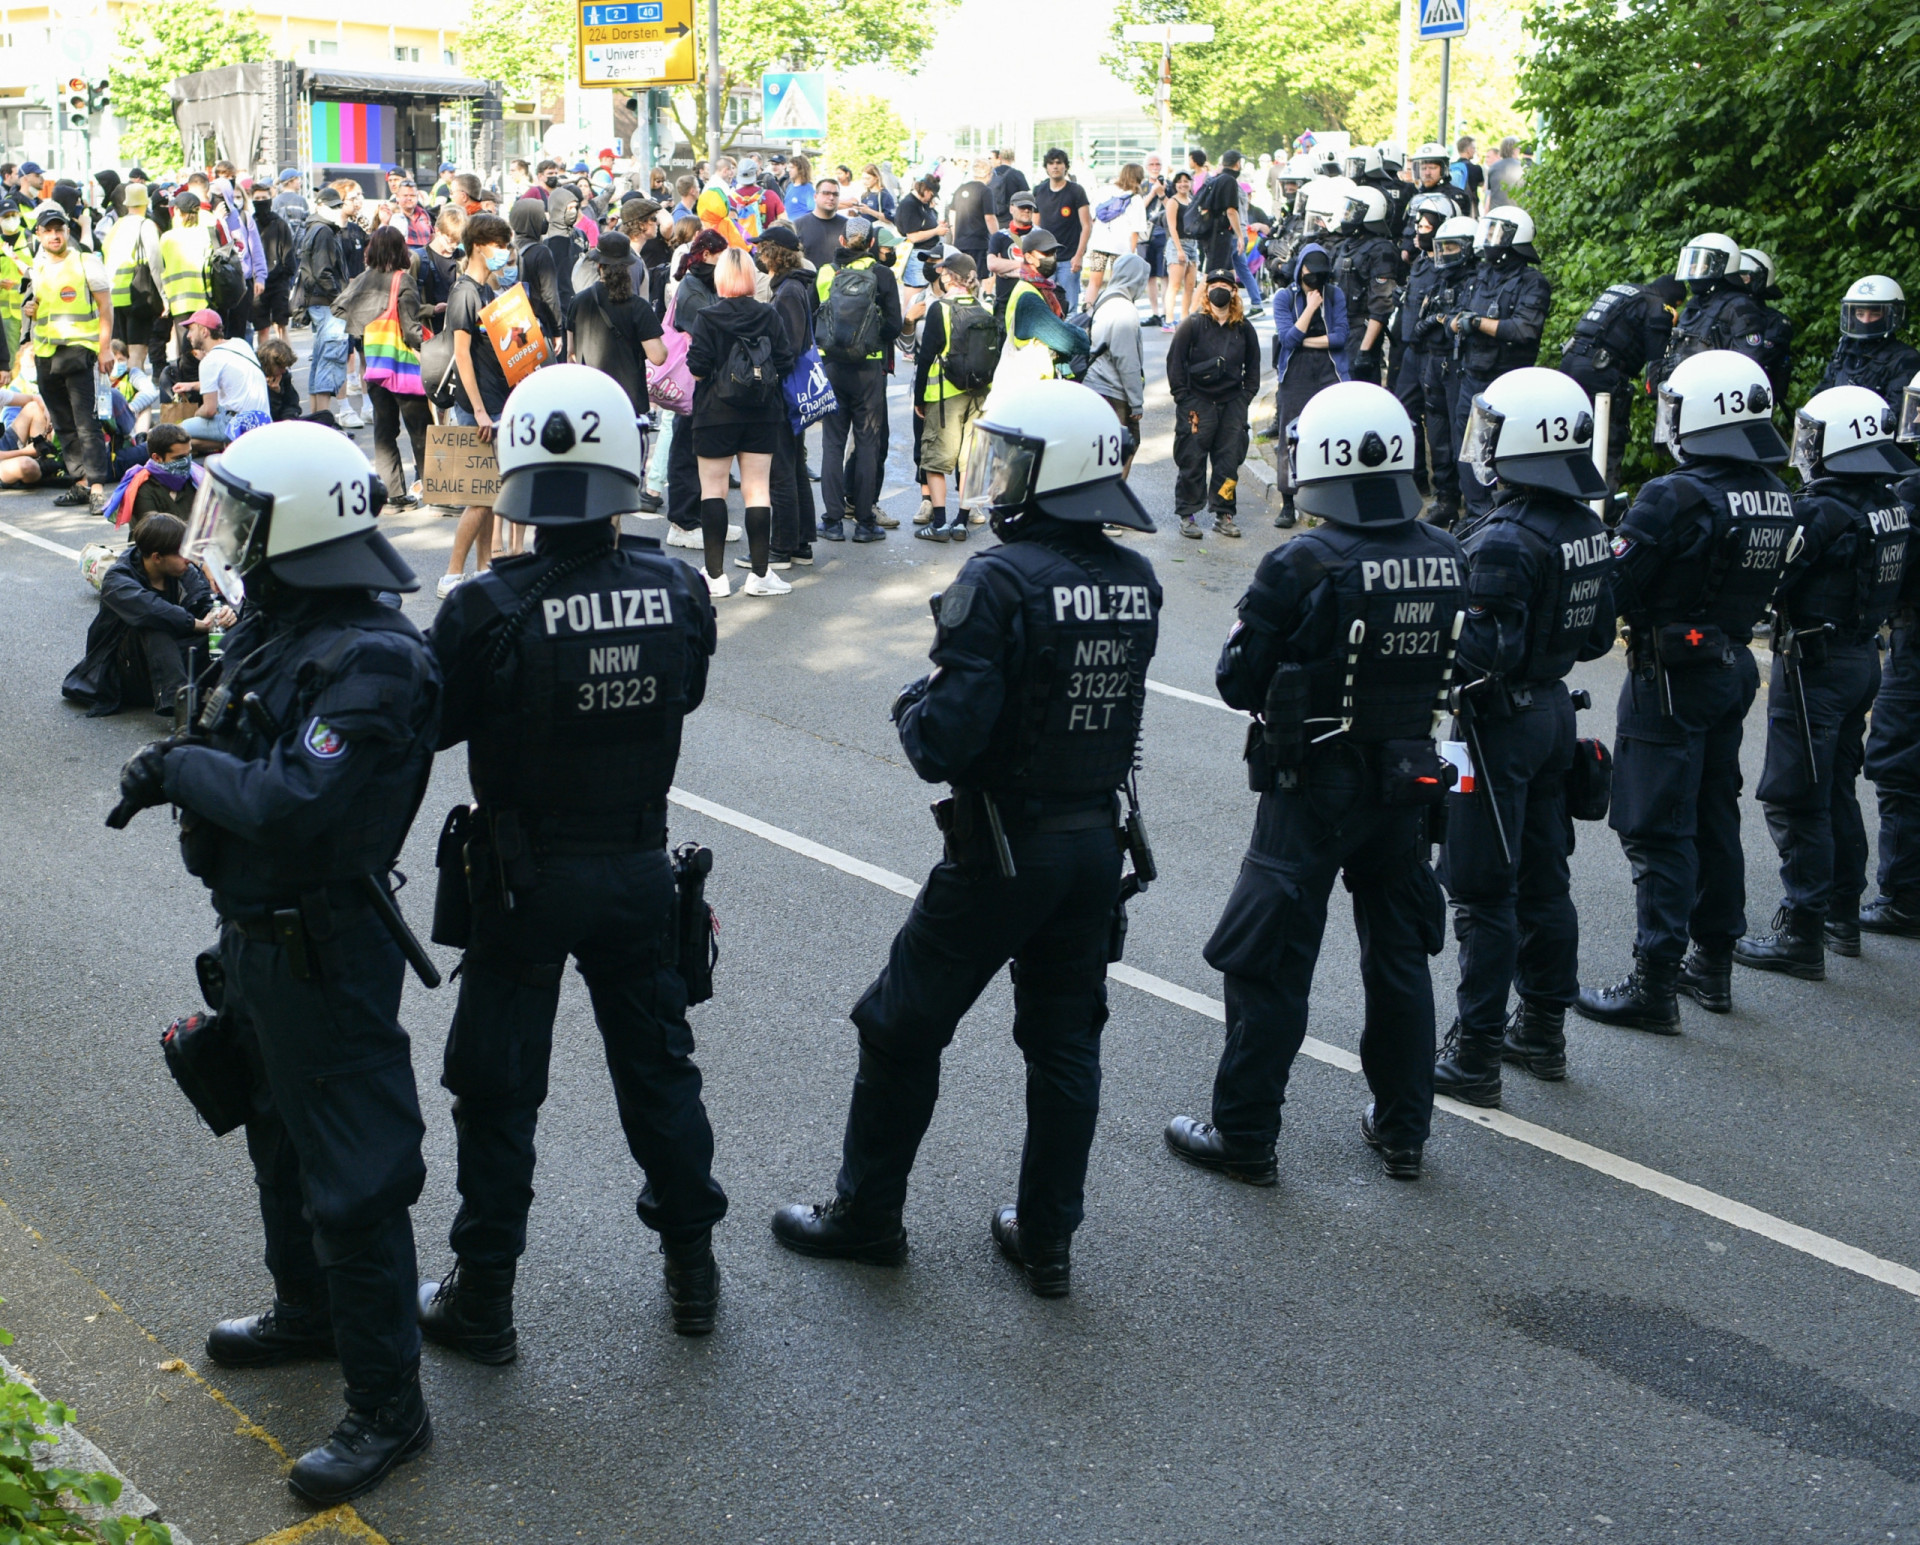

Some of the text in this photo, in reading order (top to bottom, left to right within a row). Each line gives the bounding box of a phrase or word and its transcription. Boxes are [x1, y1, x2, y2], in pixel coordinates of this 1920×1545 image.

[613, 10, 619, 19] 2
[642, 8, 654, 17] 40
[589, 27, 659, 42] 224 Dorsten
[605, 46, 663, 61] Univers
[506, 339, 539, 369] STOPPEN!
[1713, 390, 1745, 416] 13
[507, 412, 536, 448] 13
[580, 410, 601, 443] 2
[1535, 416, 1569, 444] 13
[1848, 415, 1878, 440] 13
[1091, 434, 1120, 467] 13
[1319, 434, 1404, 467] 13 2
[328, 480, 367, 518] 13
[425, 478, 465, 493] BLAUE
[1726, 490, 1794, 517] POLIZEI
[1748, 527, 1785, 548] NRW
[1741, 549, 1781, 569] 31321
[1881, 541, 1906, 564] NRW
[1361, 557, 1461, 592] POLIZEI
[1052, 584, 1152, 621] POLIZEI
[1569, 575, 1602, 603] NRW
[542, 587, 673, 635] POLIZEI
[1393, 601, 1435, 624] NRW
[1563, 603, 1597, 630] 31321
[1380, 630, 1440, 656] 31321
[589, 644, 640, 675] NRW
[577, 675, 657, 711] 31323
[1067, 671, 1130, 699] 31322
[1068, 702, 1116, 731] FLT
